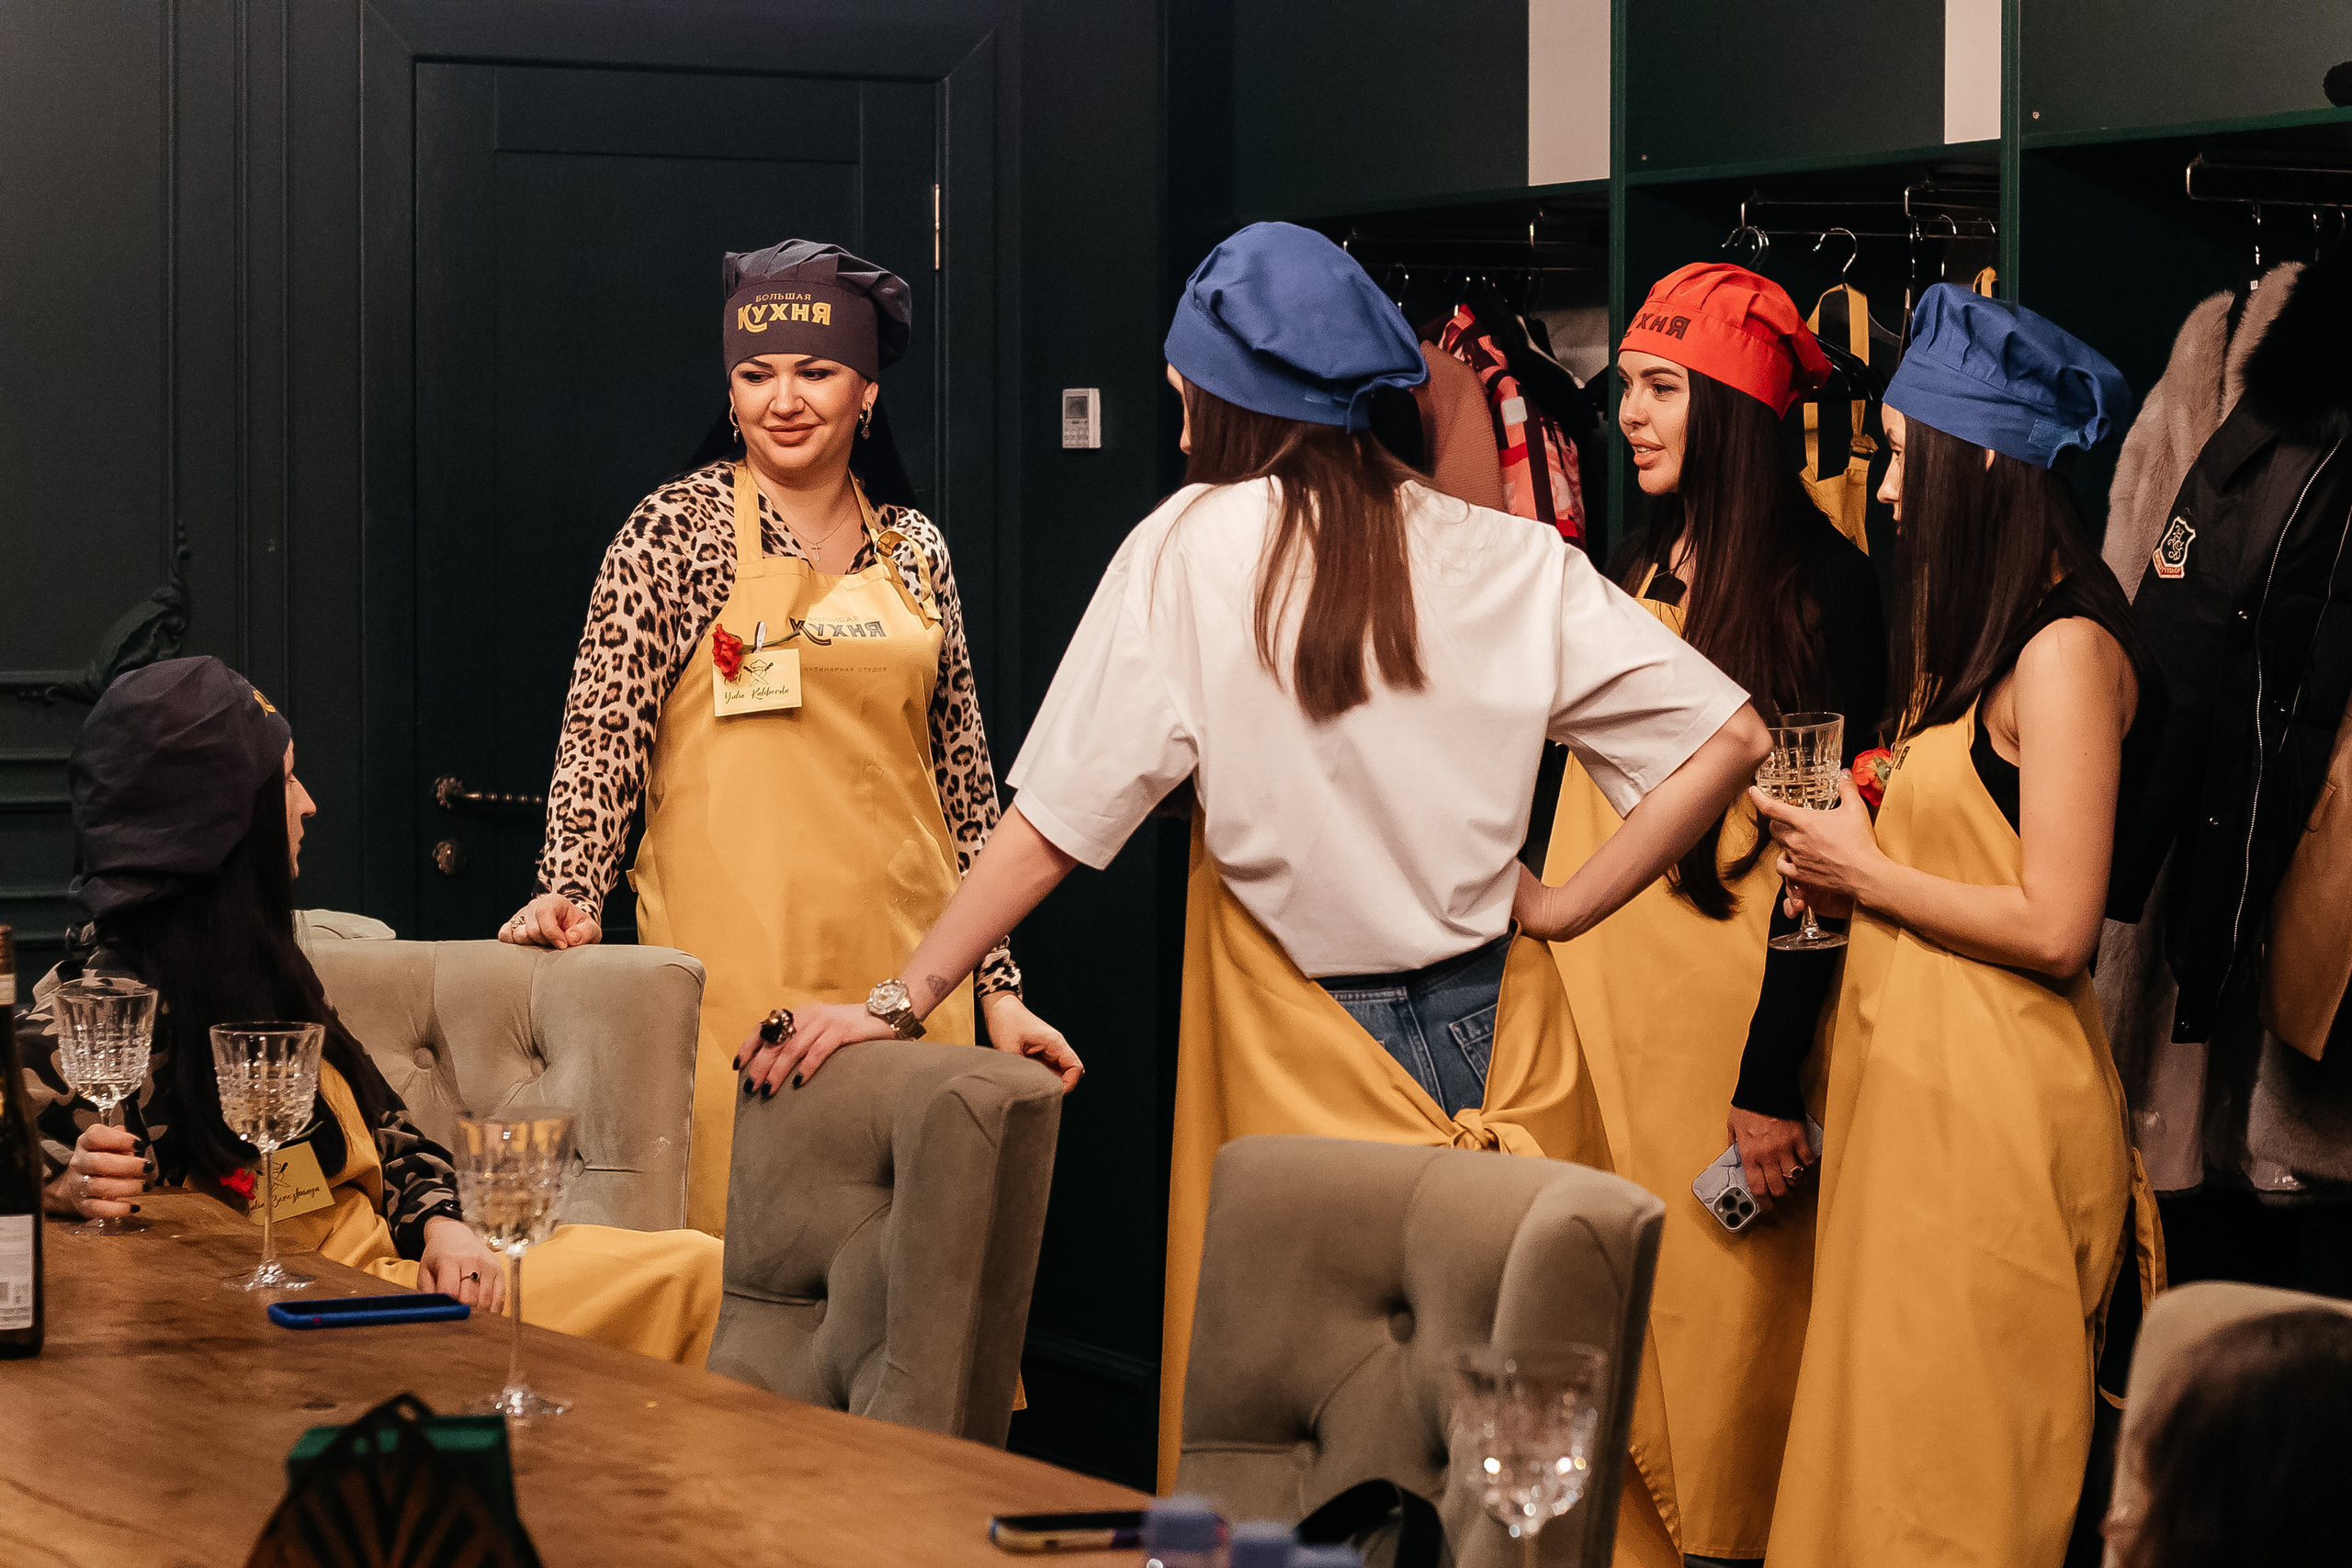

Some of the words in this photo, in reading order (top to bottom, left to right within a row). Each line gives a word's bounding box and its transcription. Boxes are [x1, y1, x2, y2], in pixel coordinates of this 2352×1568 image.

[755, 293, 811, 302] БОЛЬШАЯ
[738, 302, 831, 333] КУХНЯ
[1623, 312, 1691, 340] ХНЯ
